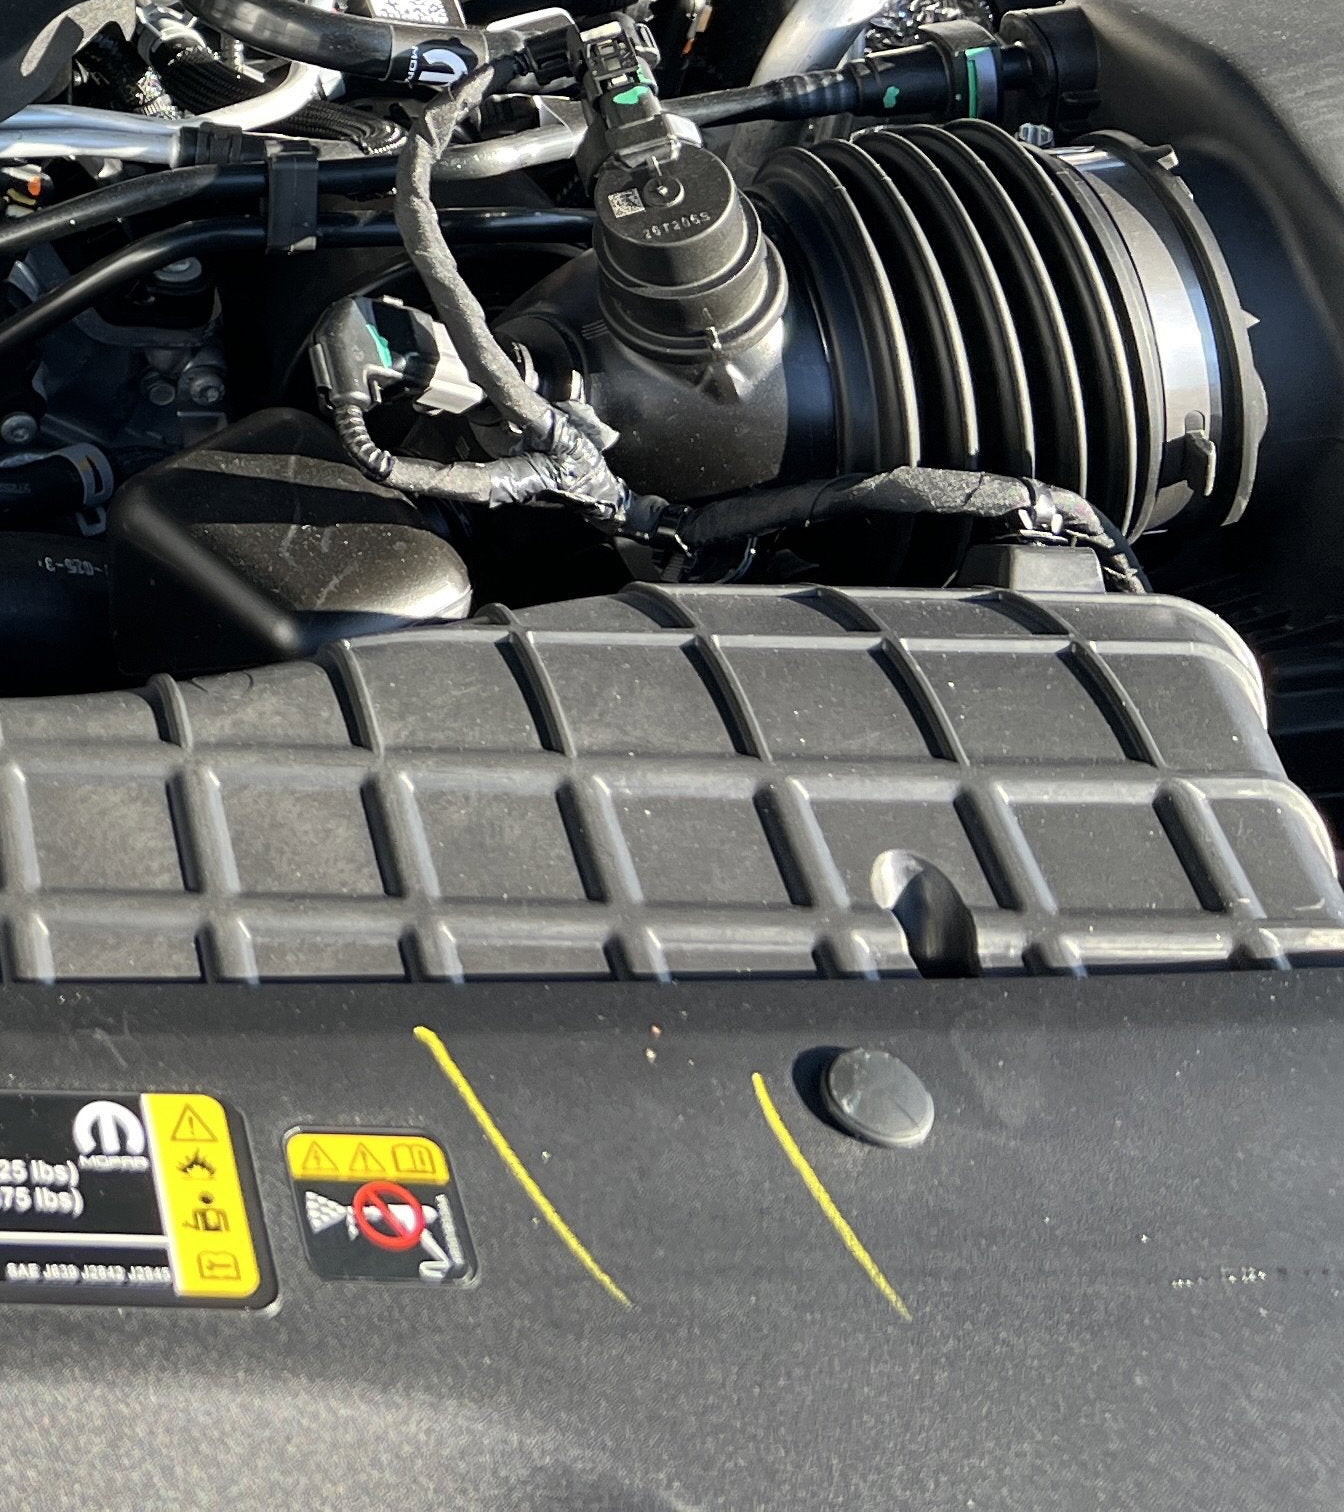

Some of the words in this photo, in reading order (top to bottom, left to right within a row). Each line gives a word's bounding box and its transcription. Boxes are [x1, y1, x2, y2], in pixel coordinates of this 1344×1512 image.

[30, 1159, 79, 1188] lbs)
[78, 1155, 149, 1172] MOPAR
[34, 1187, 85, 1219] lbs)
[6, 1262, 41, 1283] SAE
